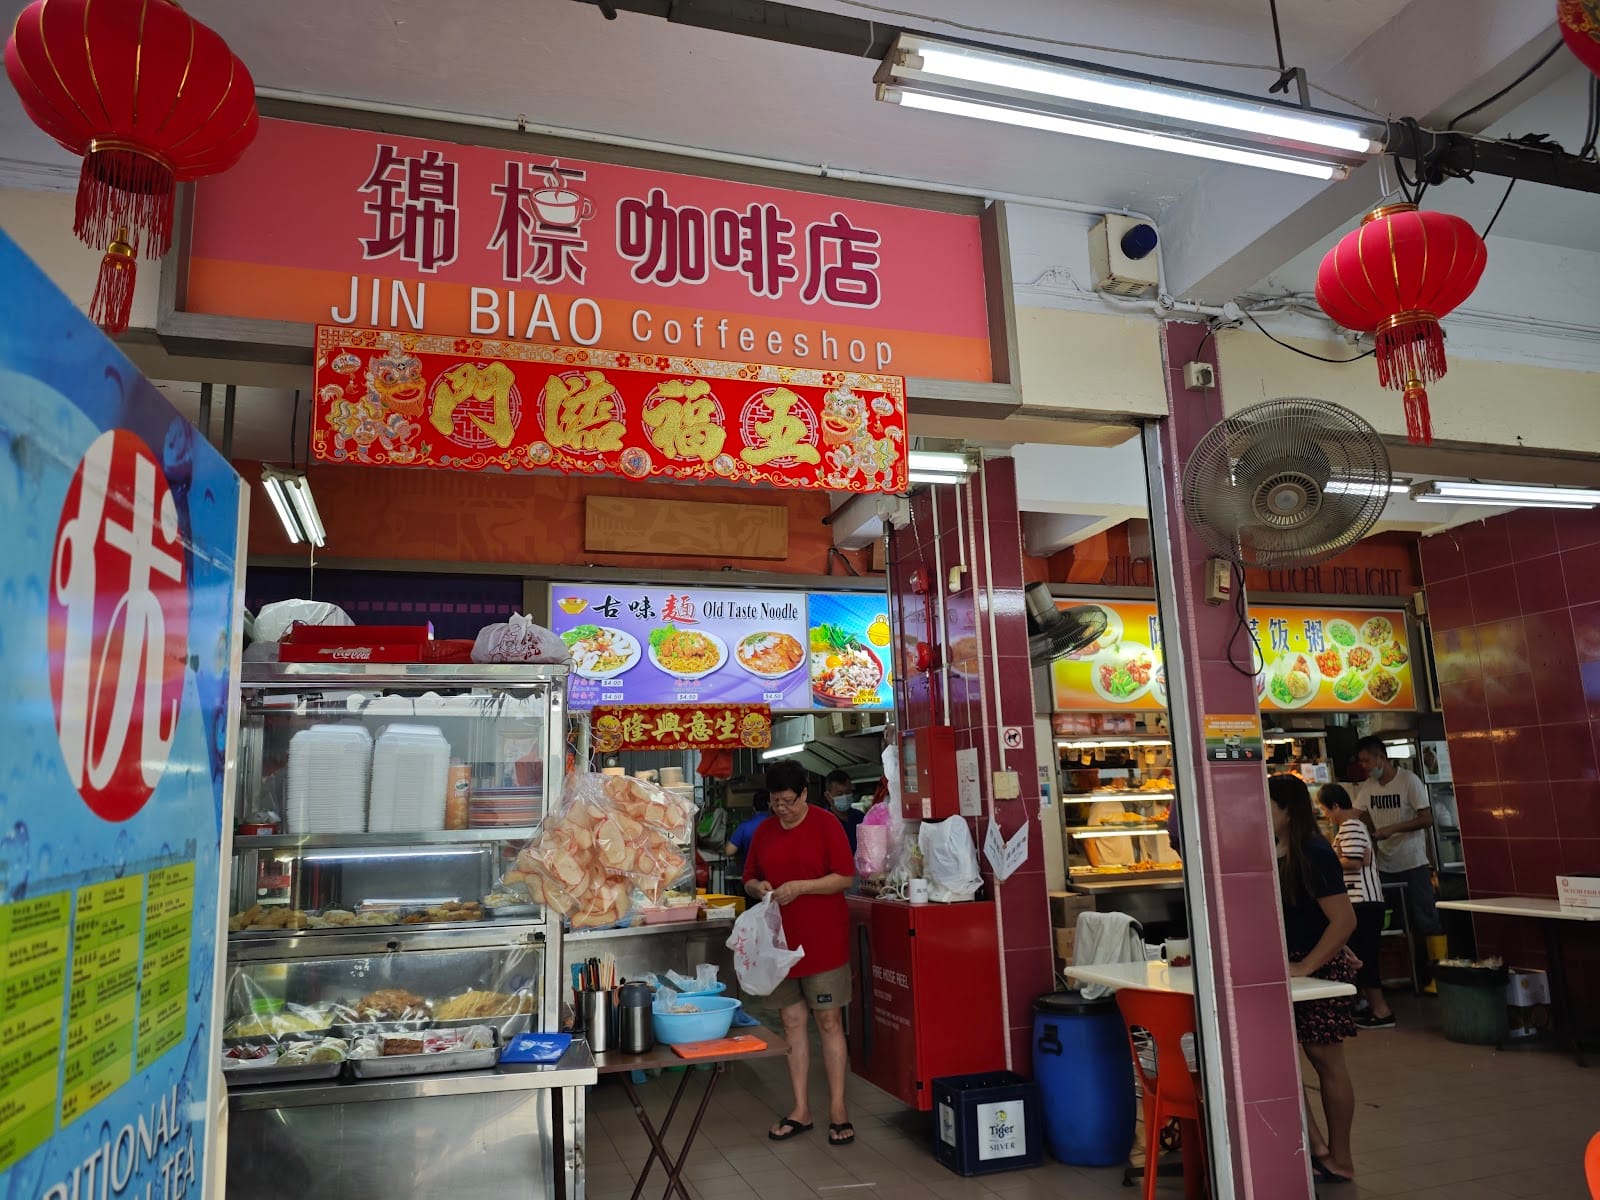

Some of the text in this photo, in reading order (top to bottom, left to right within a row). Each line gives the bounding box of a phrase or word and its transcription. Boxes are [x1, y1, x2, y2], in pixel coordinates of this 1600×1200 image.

[331, 276, 892, 371] JIN BIAO Coffeeshop
[1333, 567, 1402, 596] DELIGHT
[703, 600, 798, 620] Old Taste Noodle
[1370, 794, 1400, 809] PUMA
[989, 1124, 1014, 1138] Tiger
[990, 1142, 1016, 1152] SILVER
[162, 1136, 195, 1200] TEA
